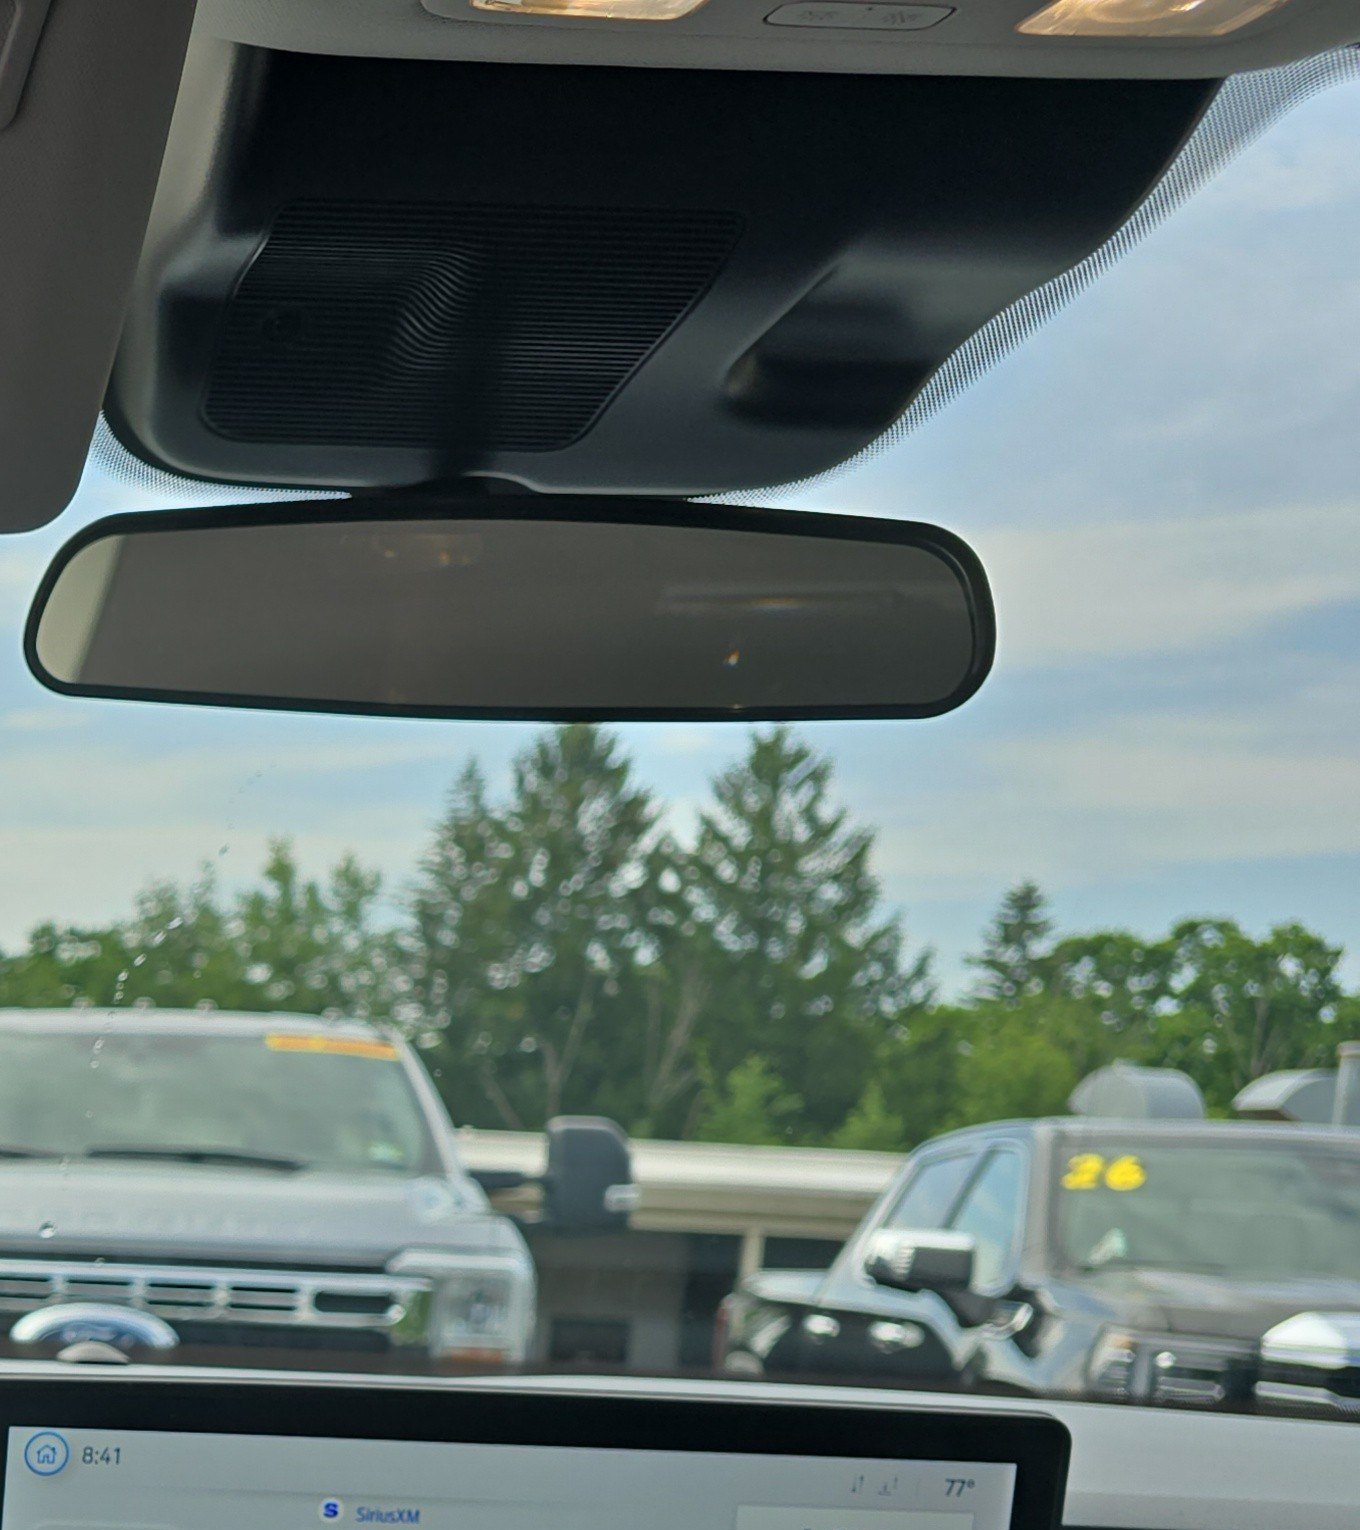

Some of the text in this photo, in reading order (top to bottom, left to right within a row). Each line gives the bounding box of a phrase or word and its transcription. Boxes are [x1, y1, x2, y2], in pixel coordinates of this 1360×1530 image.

[1061, 1152, 1147, 1192] 26
[82, 1446, 122, 1466] 8:41
[356, 1507, 421, 1524] SiriusXM
